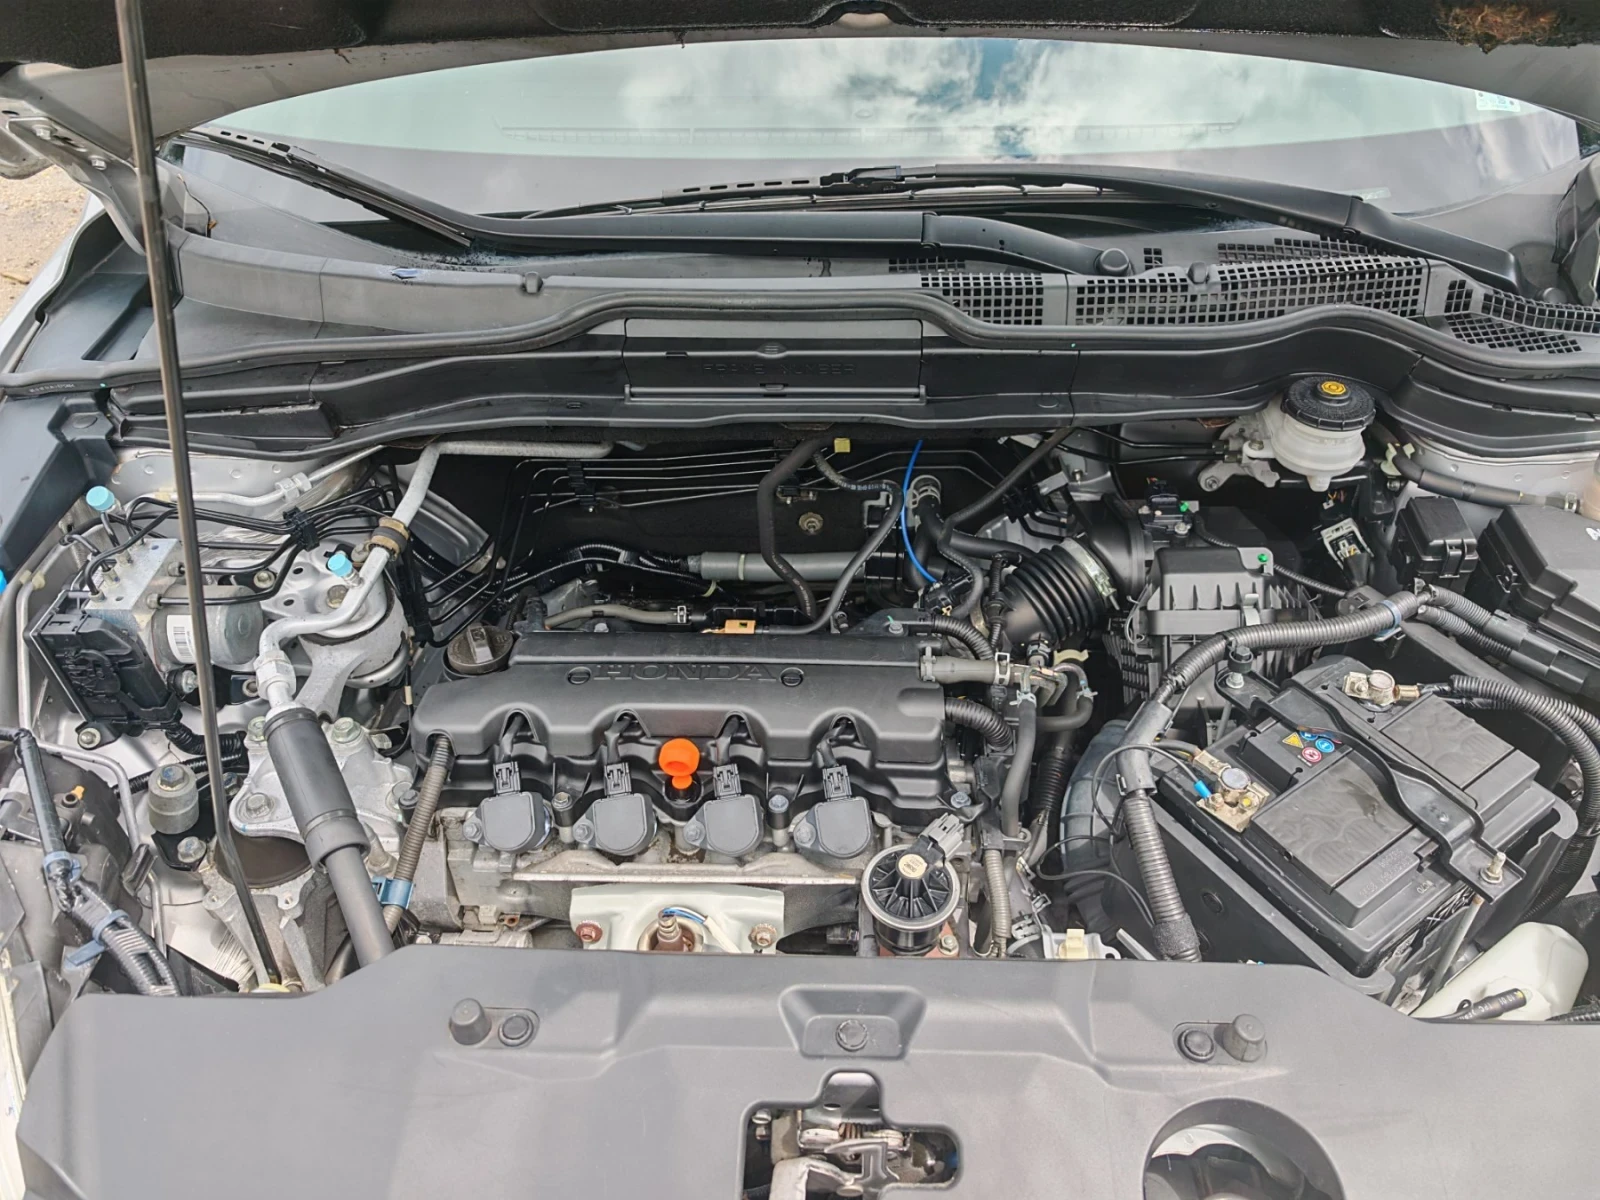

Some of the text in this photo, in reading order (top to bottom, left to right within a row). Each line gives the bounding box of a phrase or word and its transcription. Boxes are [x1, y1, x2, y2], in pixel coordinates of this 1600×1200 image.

[703, 363, 858, 375] FRAME NUMBER
[592, 664, 777, 682] HONDA
